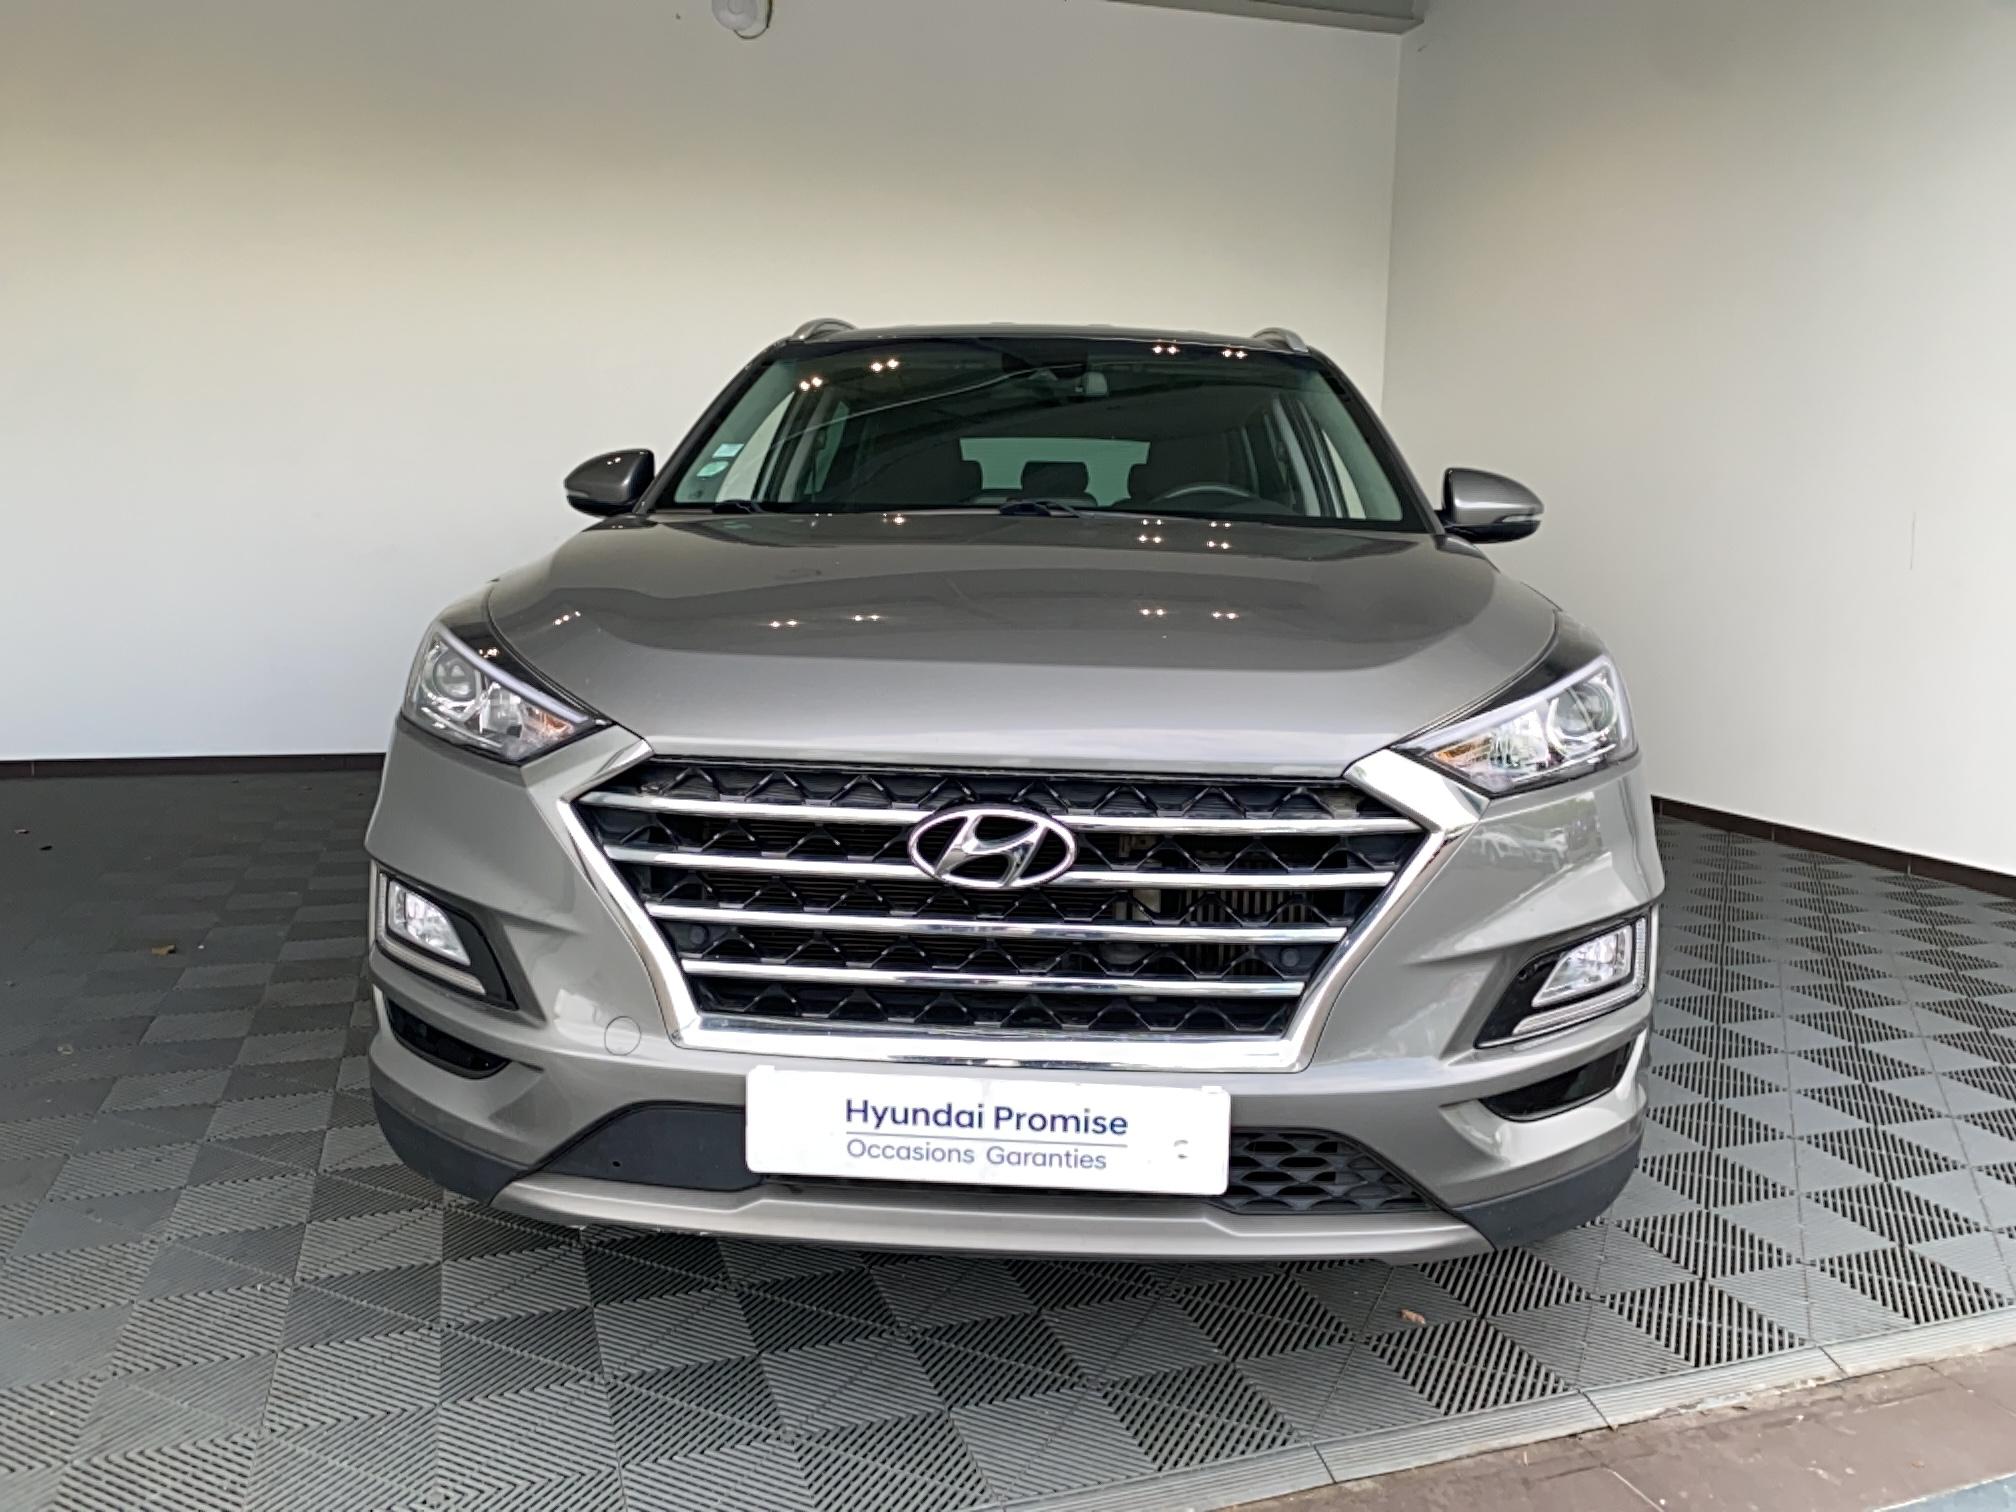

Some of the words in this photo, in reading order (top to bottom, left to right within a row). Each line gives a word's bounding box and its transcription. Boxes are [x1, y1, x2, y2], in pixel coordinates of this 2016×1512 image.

[846, 1098, 983, 1130] Hyundai
[994, 1106, 1128, 1135] Promise
[846, 1138, 975, 1165] Occasions
[986, 1146, 1107, 1170] Garanties
